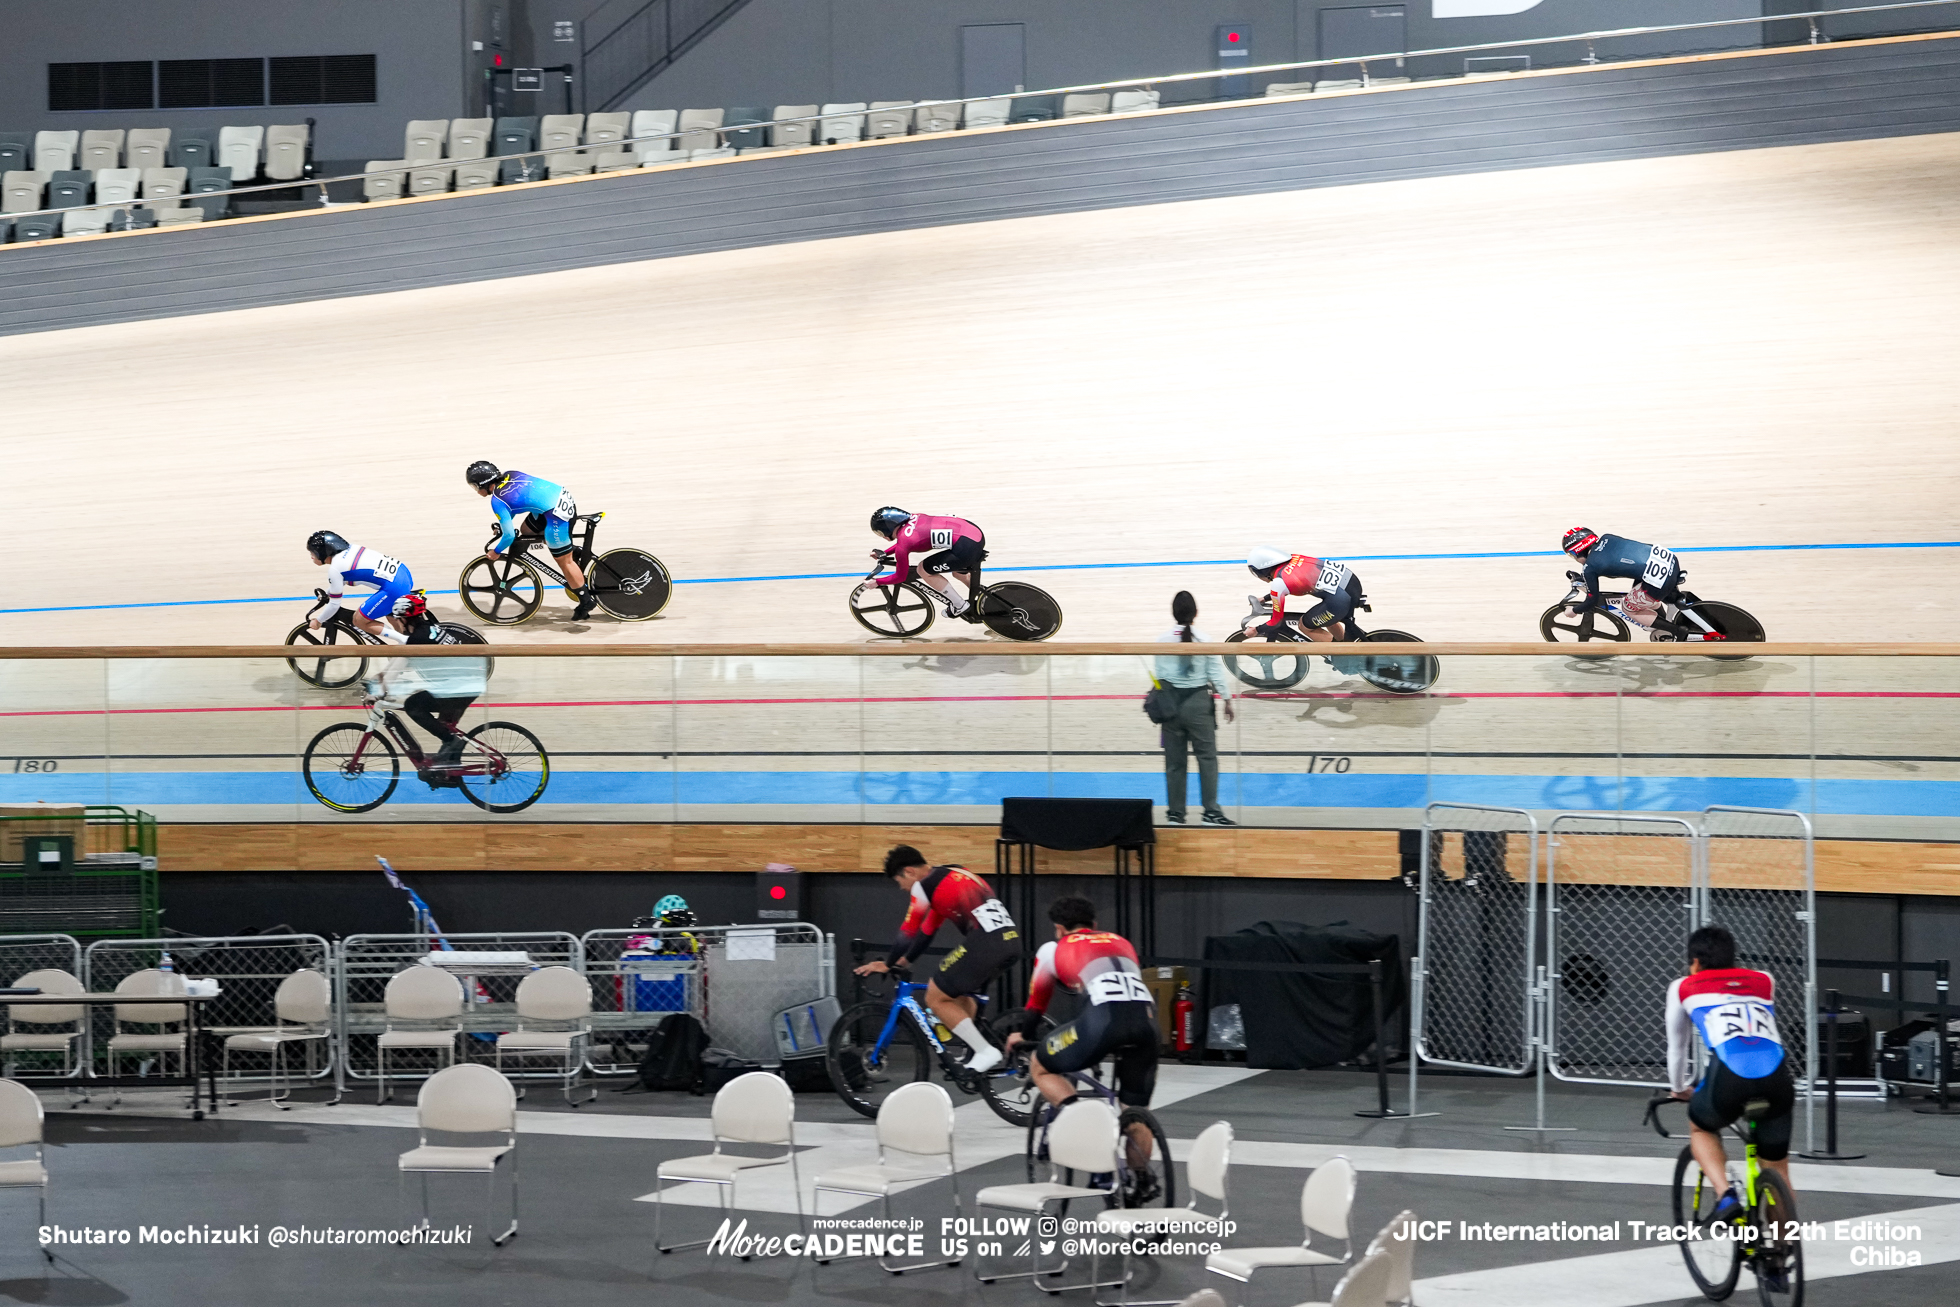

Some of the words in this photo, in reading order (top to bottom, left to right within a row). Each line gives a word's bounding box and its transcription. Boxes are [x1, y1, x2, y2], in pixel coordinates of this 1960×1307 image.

[557, 498, 574, 516] 106
[904, 514, 919, 538] QAS
[530, 543, 545, 551] 106
[931, 531, 951, 546] 101
[1652, 545, 1672, 562] 601
[377, 559, 397, 575] 110
[520, 552, 568, 585] BRIDGESTONE
[932, 562, 951, 572] QAS
[1645, 560, 1669, 580] 109
[1318, 568, 1340, 588] 103
[912, 580, 951, 606] ARGON
[1311, 609, 1335, 627] CHINA
[390, 725, 411, 752] Panasonic
[905, 1001, 944, 1054] DOGMA
